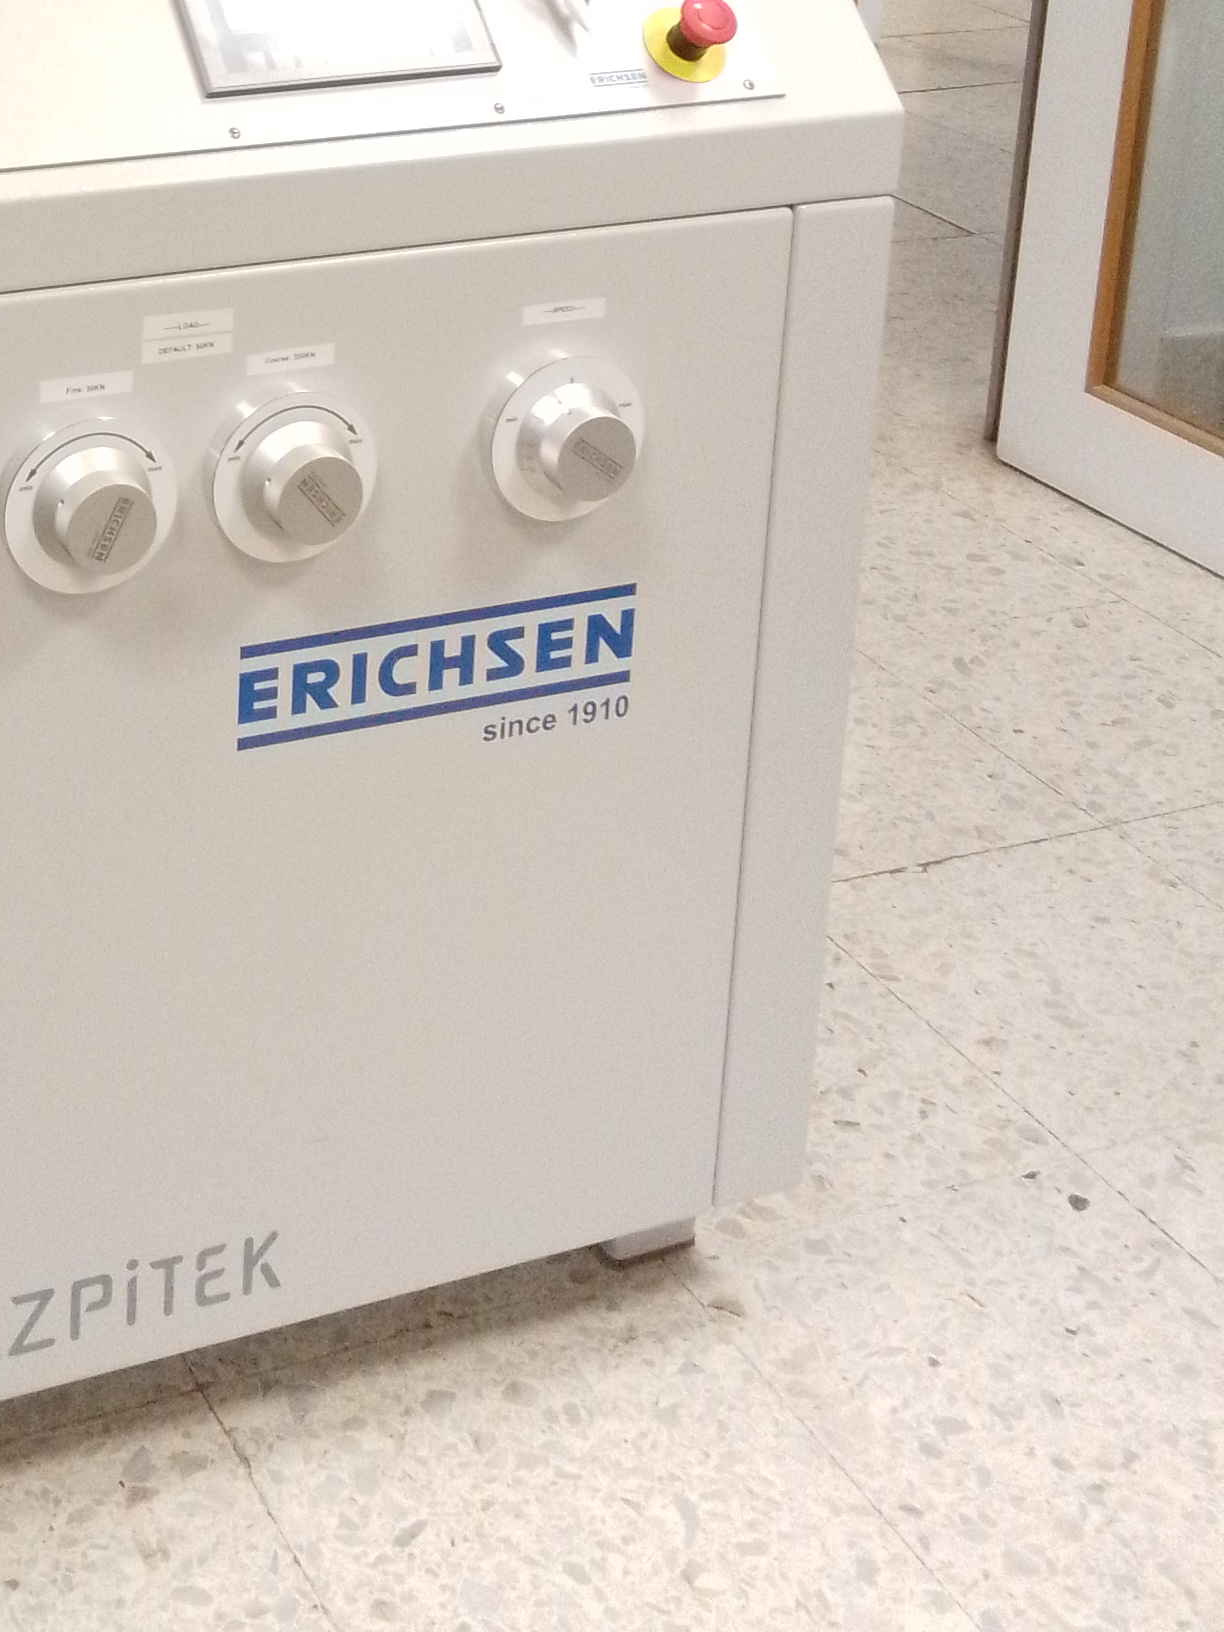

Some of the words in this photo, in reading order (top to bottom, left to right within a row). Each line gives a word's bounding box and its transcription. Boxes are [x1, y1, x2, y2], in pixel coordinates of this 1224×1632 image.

[237, 607, 636, 725] ERICHSEN
[482, 713, 558, 743] since
[568, 694, 630, 728] 1910
